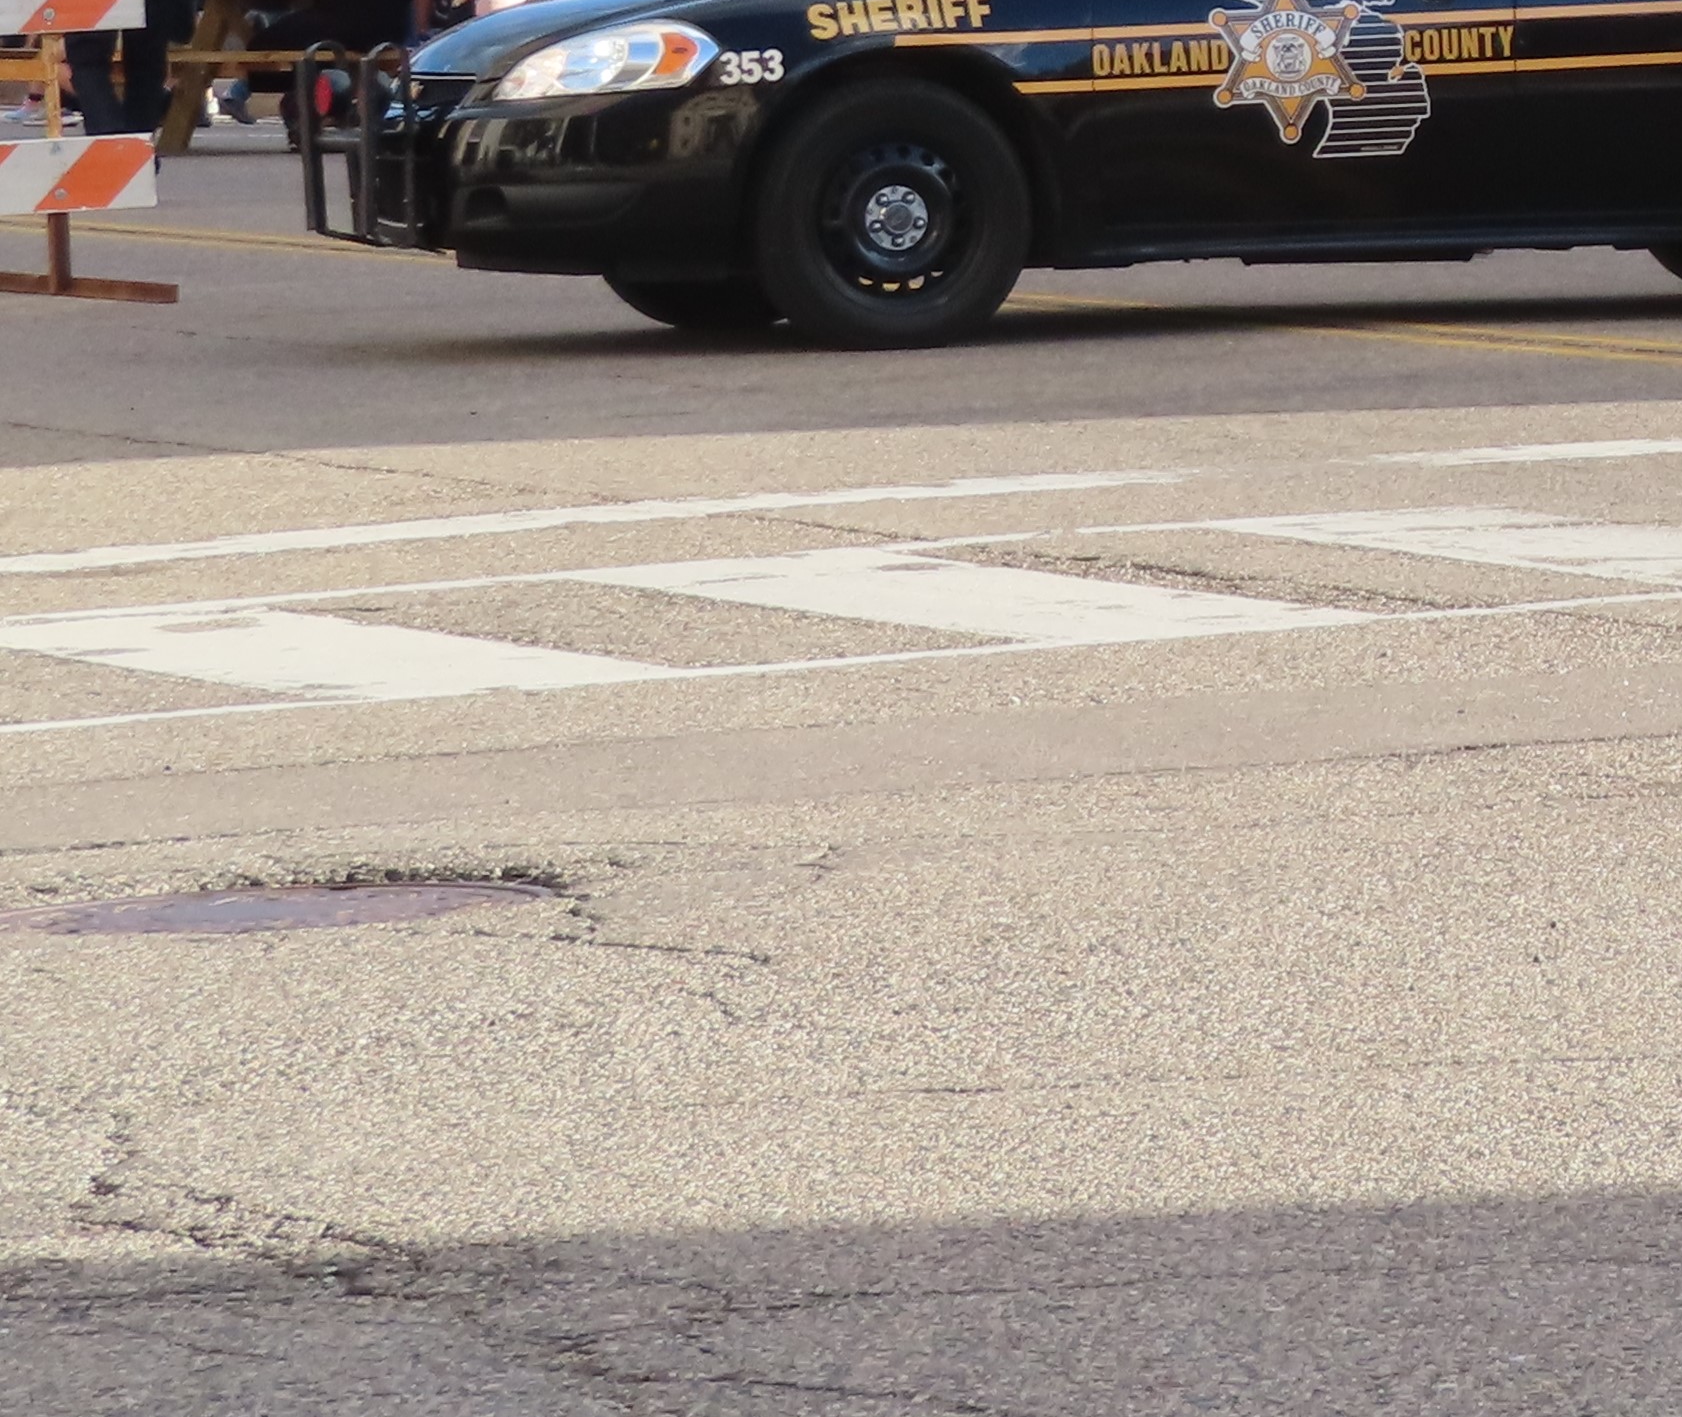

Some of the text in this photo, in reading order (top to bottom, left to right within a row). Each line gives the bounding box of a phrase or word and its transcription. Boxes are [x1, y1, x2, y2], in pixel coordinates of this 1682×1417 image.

[1251, 12, 1327, 40] SHERIFF
[719, 48, 785, 85] 353
[1092, 25, 1515, 76] OAKLAND COUNTY
[1244, 76, 1336, 96] OAKLAND COUNTY
